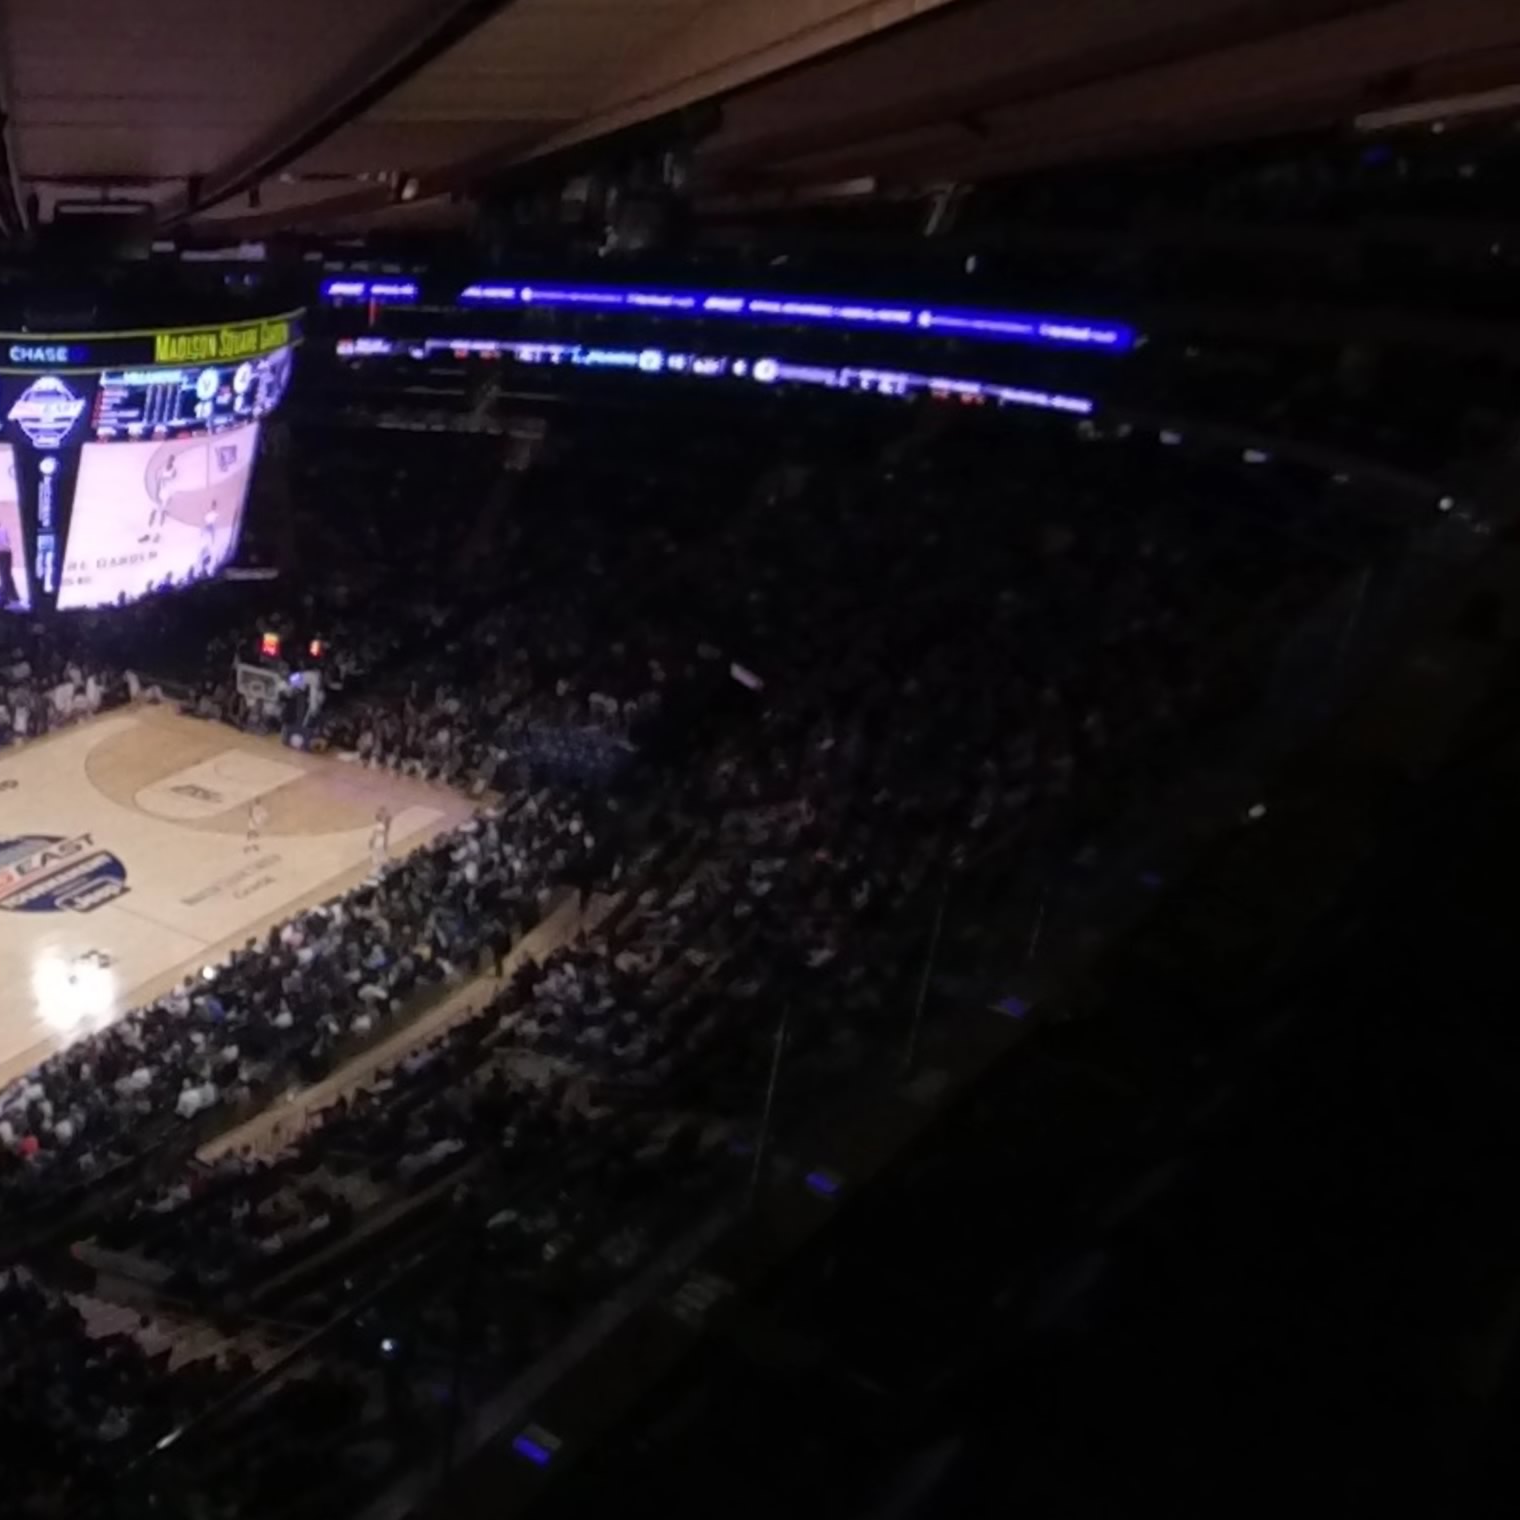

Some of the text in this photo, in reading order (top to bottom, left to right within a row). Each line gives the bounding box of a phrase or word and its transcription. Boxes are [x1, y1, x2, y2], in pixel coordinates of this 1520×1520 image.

[9, 345, 69, 362] CHASE
[155, 332, 217, 362] MADISON
[15, 833, 95, 877] EAST
